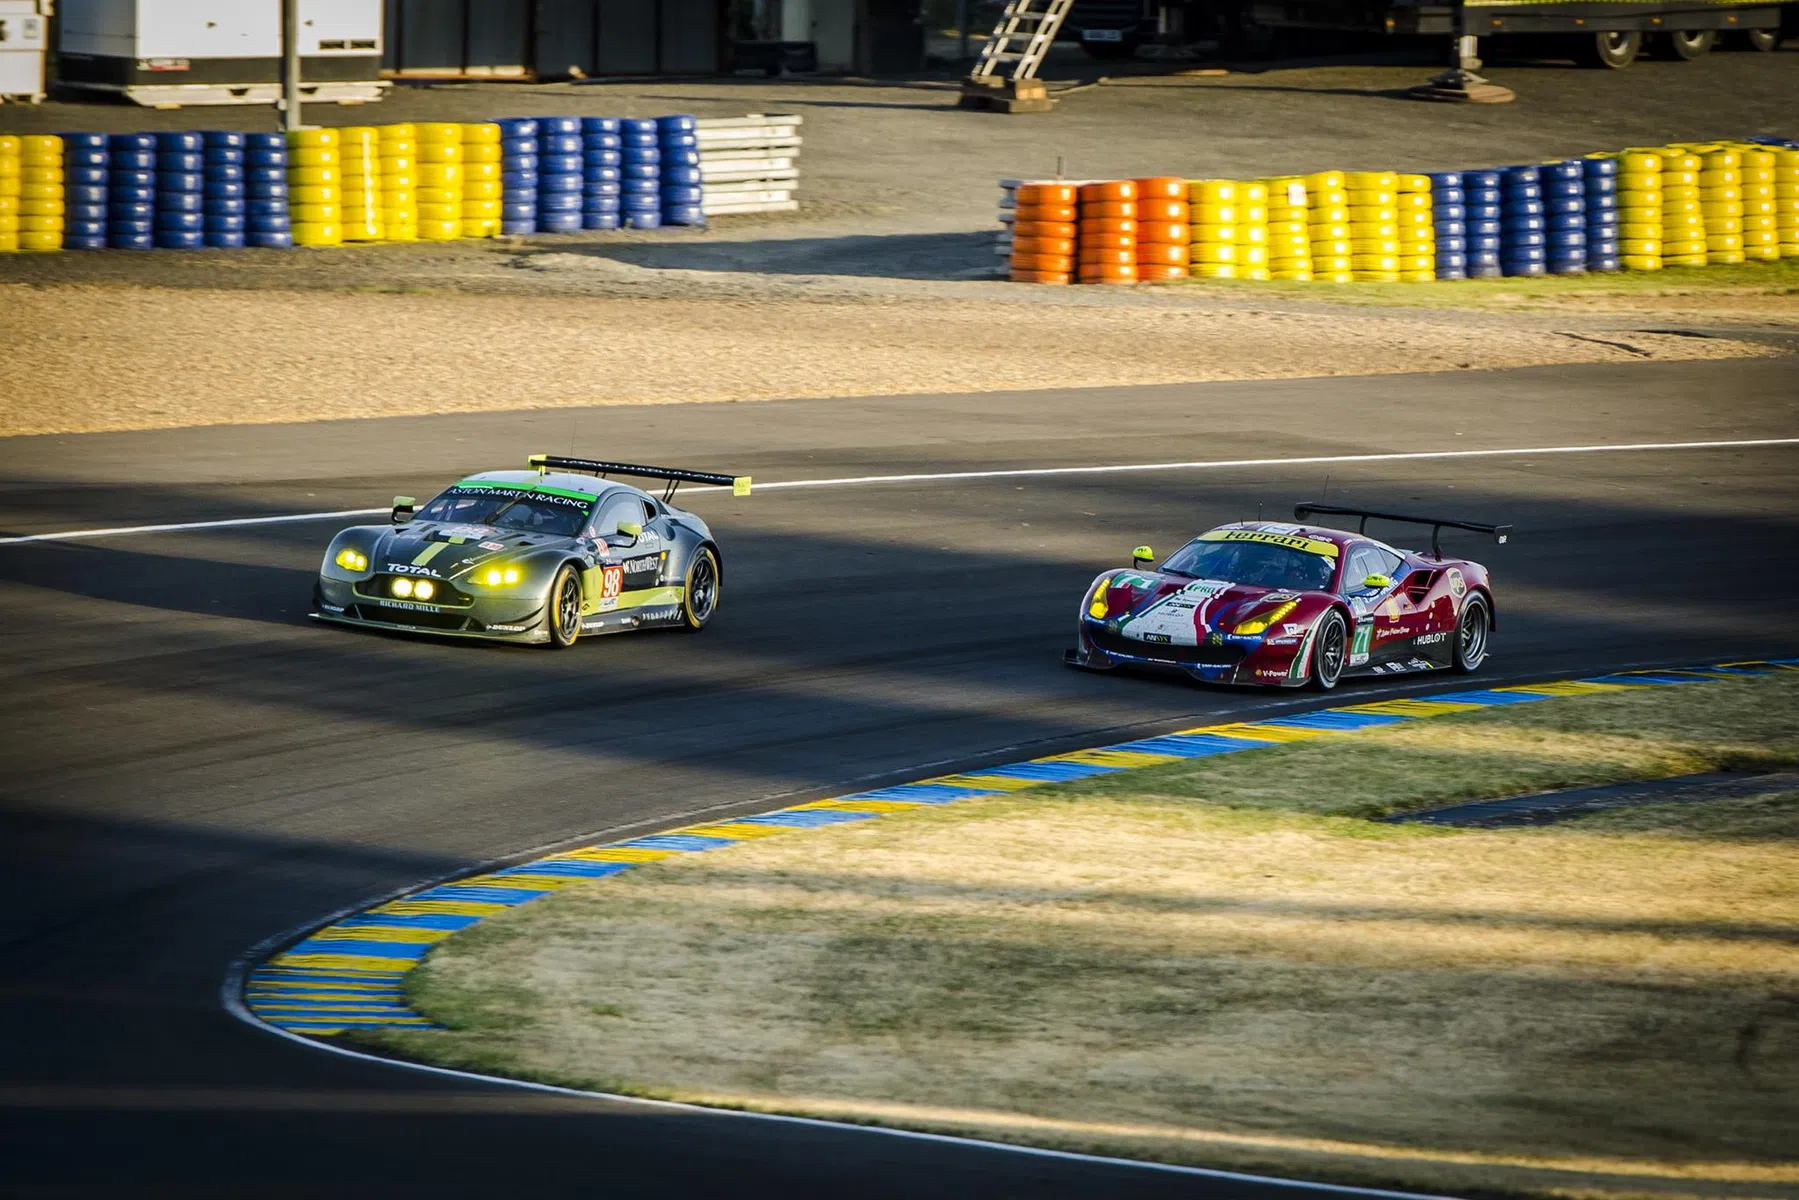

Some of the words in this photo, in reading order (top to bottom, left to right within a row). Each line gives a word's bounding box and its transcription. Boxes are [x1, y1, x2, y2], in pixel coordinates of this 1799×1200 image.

[447, 487, 488, 496] ASTON
[535, 492, 588, 509] RACING
[1223, 531, 1310, 550] Ferrari
[387, 562, 442, 578] TOTAL
[603, 567, 621, 599] 98
[379, 600, 414, 611] RICHARD
[415, 603, 440, 614] MILLE
[491, 623, 527, 633] DUNLOP
[1144, 633, 1169, 642] ANSYS
[1353, 626, 1371, 655] 71
[1416, 632, 1447, 646] HUBLOT
